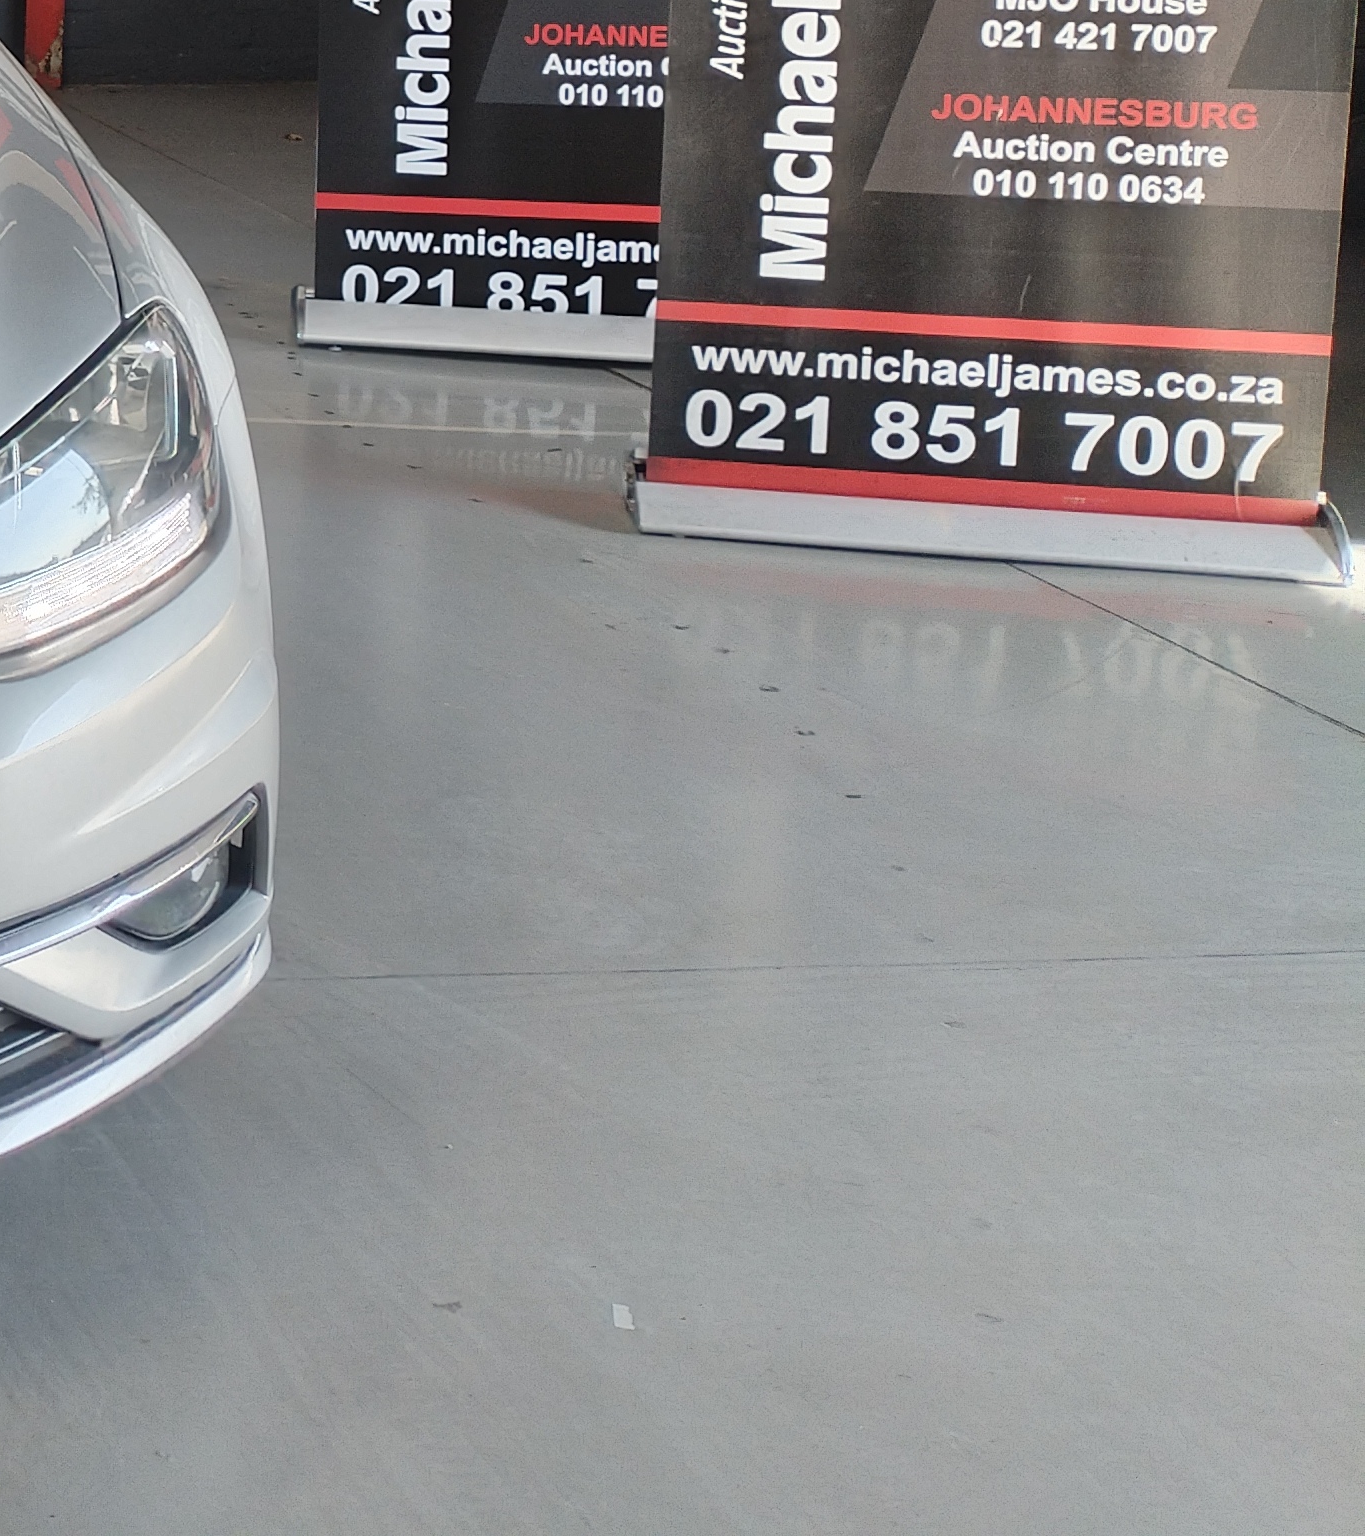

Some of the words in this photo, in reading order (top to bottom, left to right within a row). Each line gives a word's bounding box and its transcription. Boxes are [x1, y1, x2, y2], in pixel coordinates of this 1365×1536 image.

[981, 20, 1041, 48] 021
[1054, 22, 1116, 50] 421
[1131, 24, 1217, 53] 7007
[542, 53, 652, 77] Auction
[559, 83, 607, 106] 010
[617, 85, 663, 107] 110
[931, 94, 1257, 130] JOHANNESBURG
[953, 131, 1095, 162] Auction
[1107, 136, 1229, 168] Centre
[973, 168, 1036, 198] 010
[1048, 172, 1108, 201] 110
[1119, 174, 1205, 204] 0634
[692, 343, 1284, 405] www.michaeljames.co.za
[686, 390, 829, 454] 021
[872, 401, 1020, 466] 851
[1064, 412, 1284, 483] 7007
